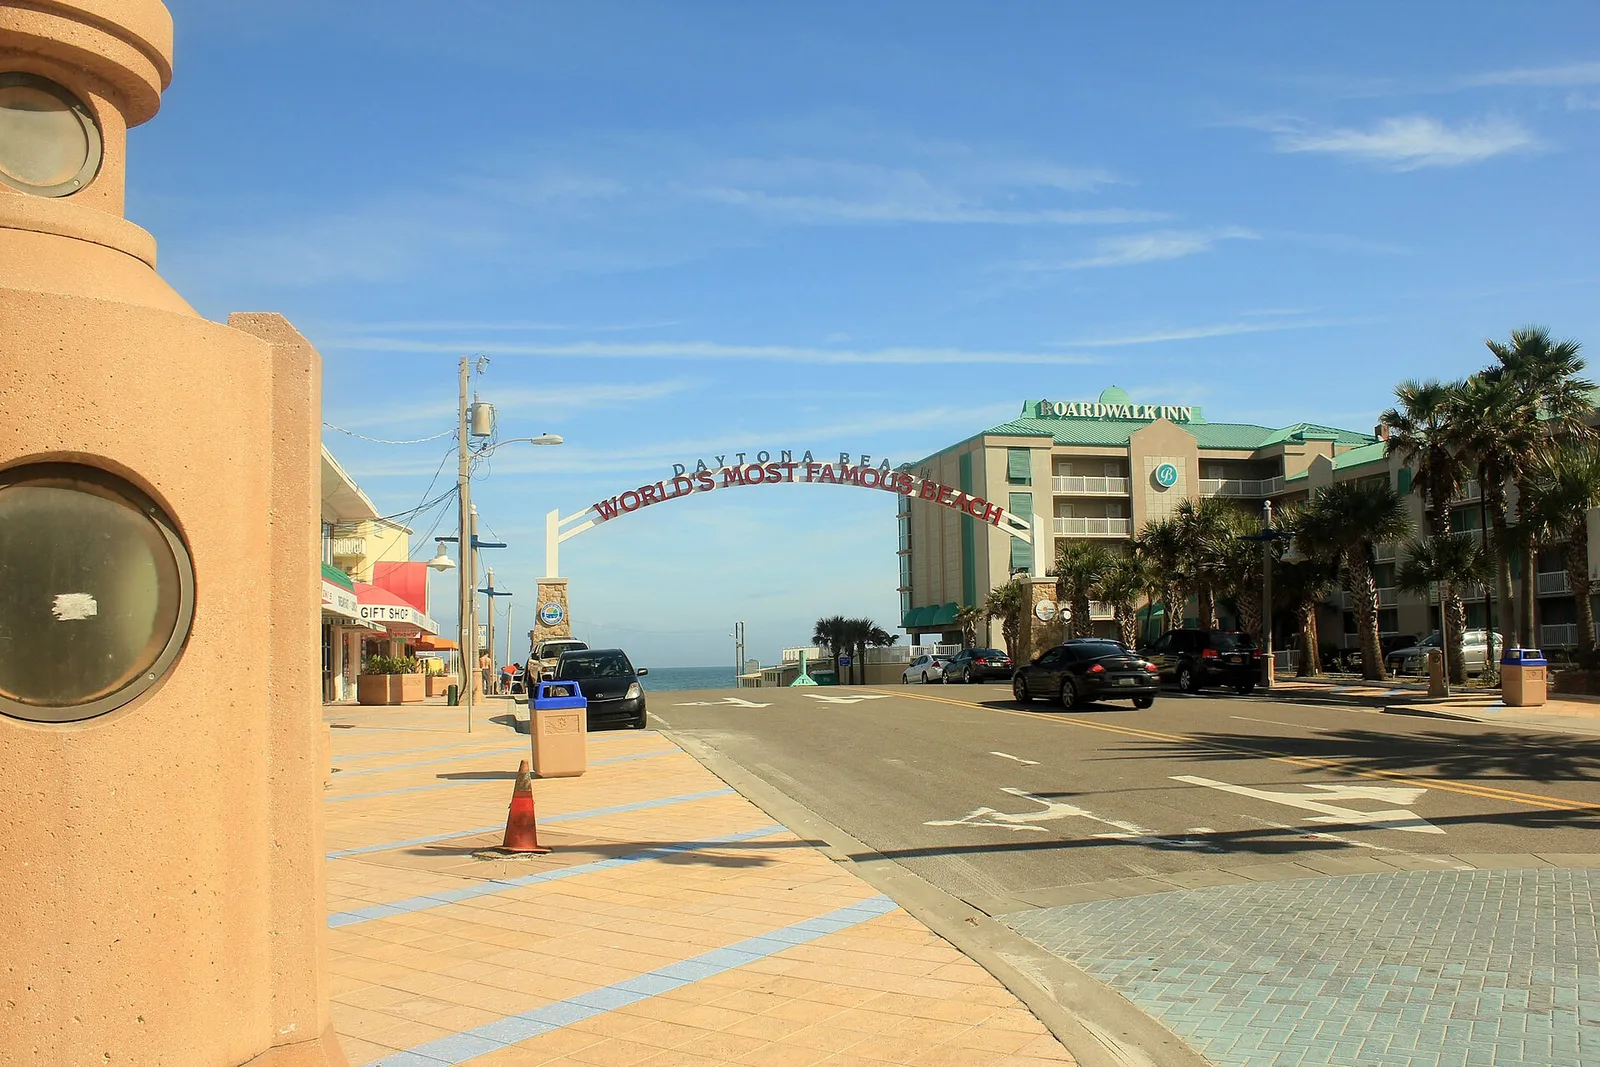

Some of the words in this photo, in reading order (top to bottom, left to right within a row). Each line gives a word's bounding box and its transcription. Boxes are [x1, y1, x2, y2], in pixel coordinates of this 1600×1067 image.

[1040, 400, 1157, 420] BOARDWALK
[1161, 405, 1192, 421] INN
[672, 449, 814, 477] DAYTONA
[839, 452, 933, 480] BEACH
[593, 470, 716, 521] WORLD'S
[722, 463, 799, 488] MOST
[805, 463, 914, 495] FAMOUS
[918, 478, 1005, 526] BEACH
[361, 607, 385, 618] GIFT
[389, 608, 408, 619] SHOP
